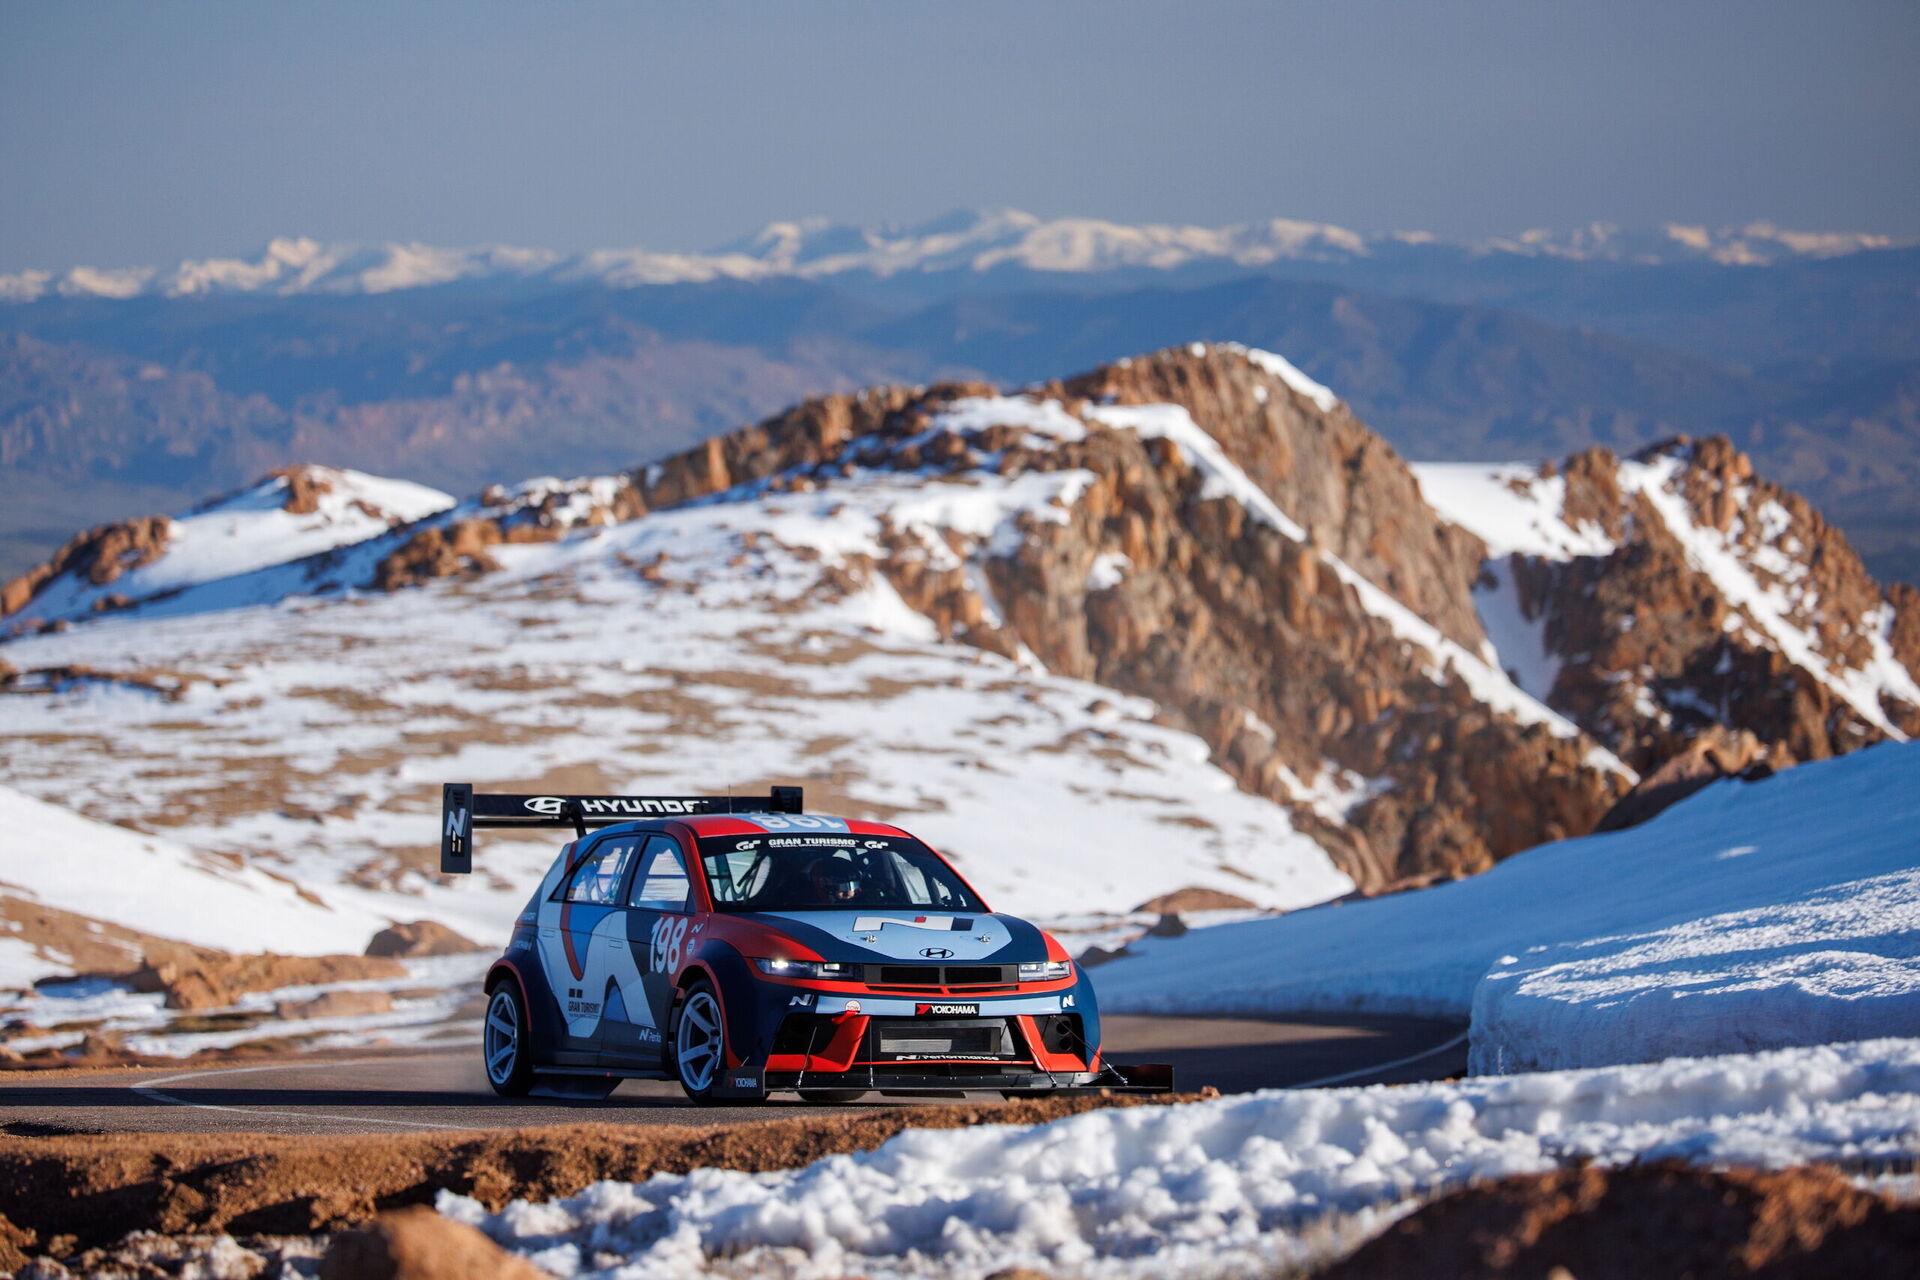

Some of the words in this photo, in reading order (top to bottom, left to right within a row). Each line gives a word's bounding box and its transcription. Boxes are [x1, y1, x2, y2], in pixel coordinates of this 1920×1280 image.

[768, 838, 801, 847] GRAN
[803, 837, 856, 846] TURISMO
[649, 916, 688, 975] 198
[931, 1005, 978, 1015] YOKOHAMA
